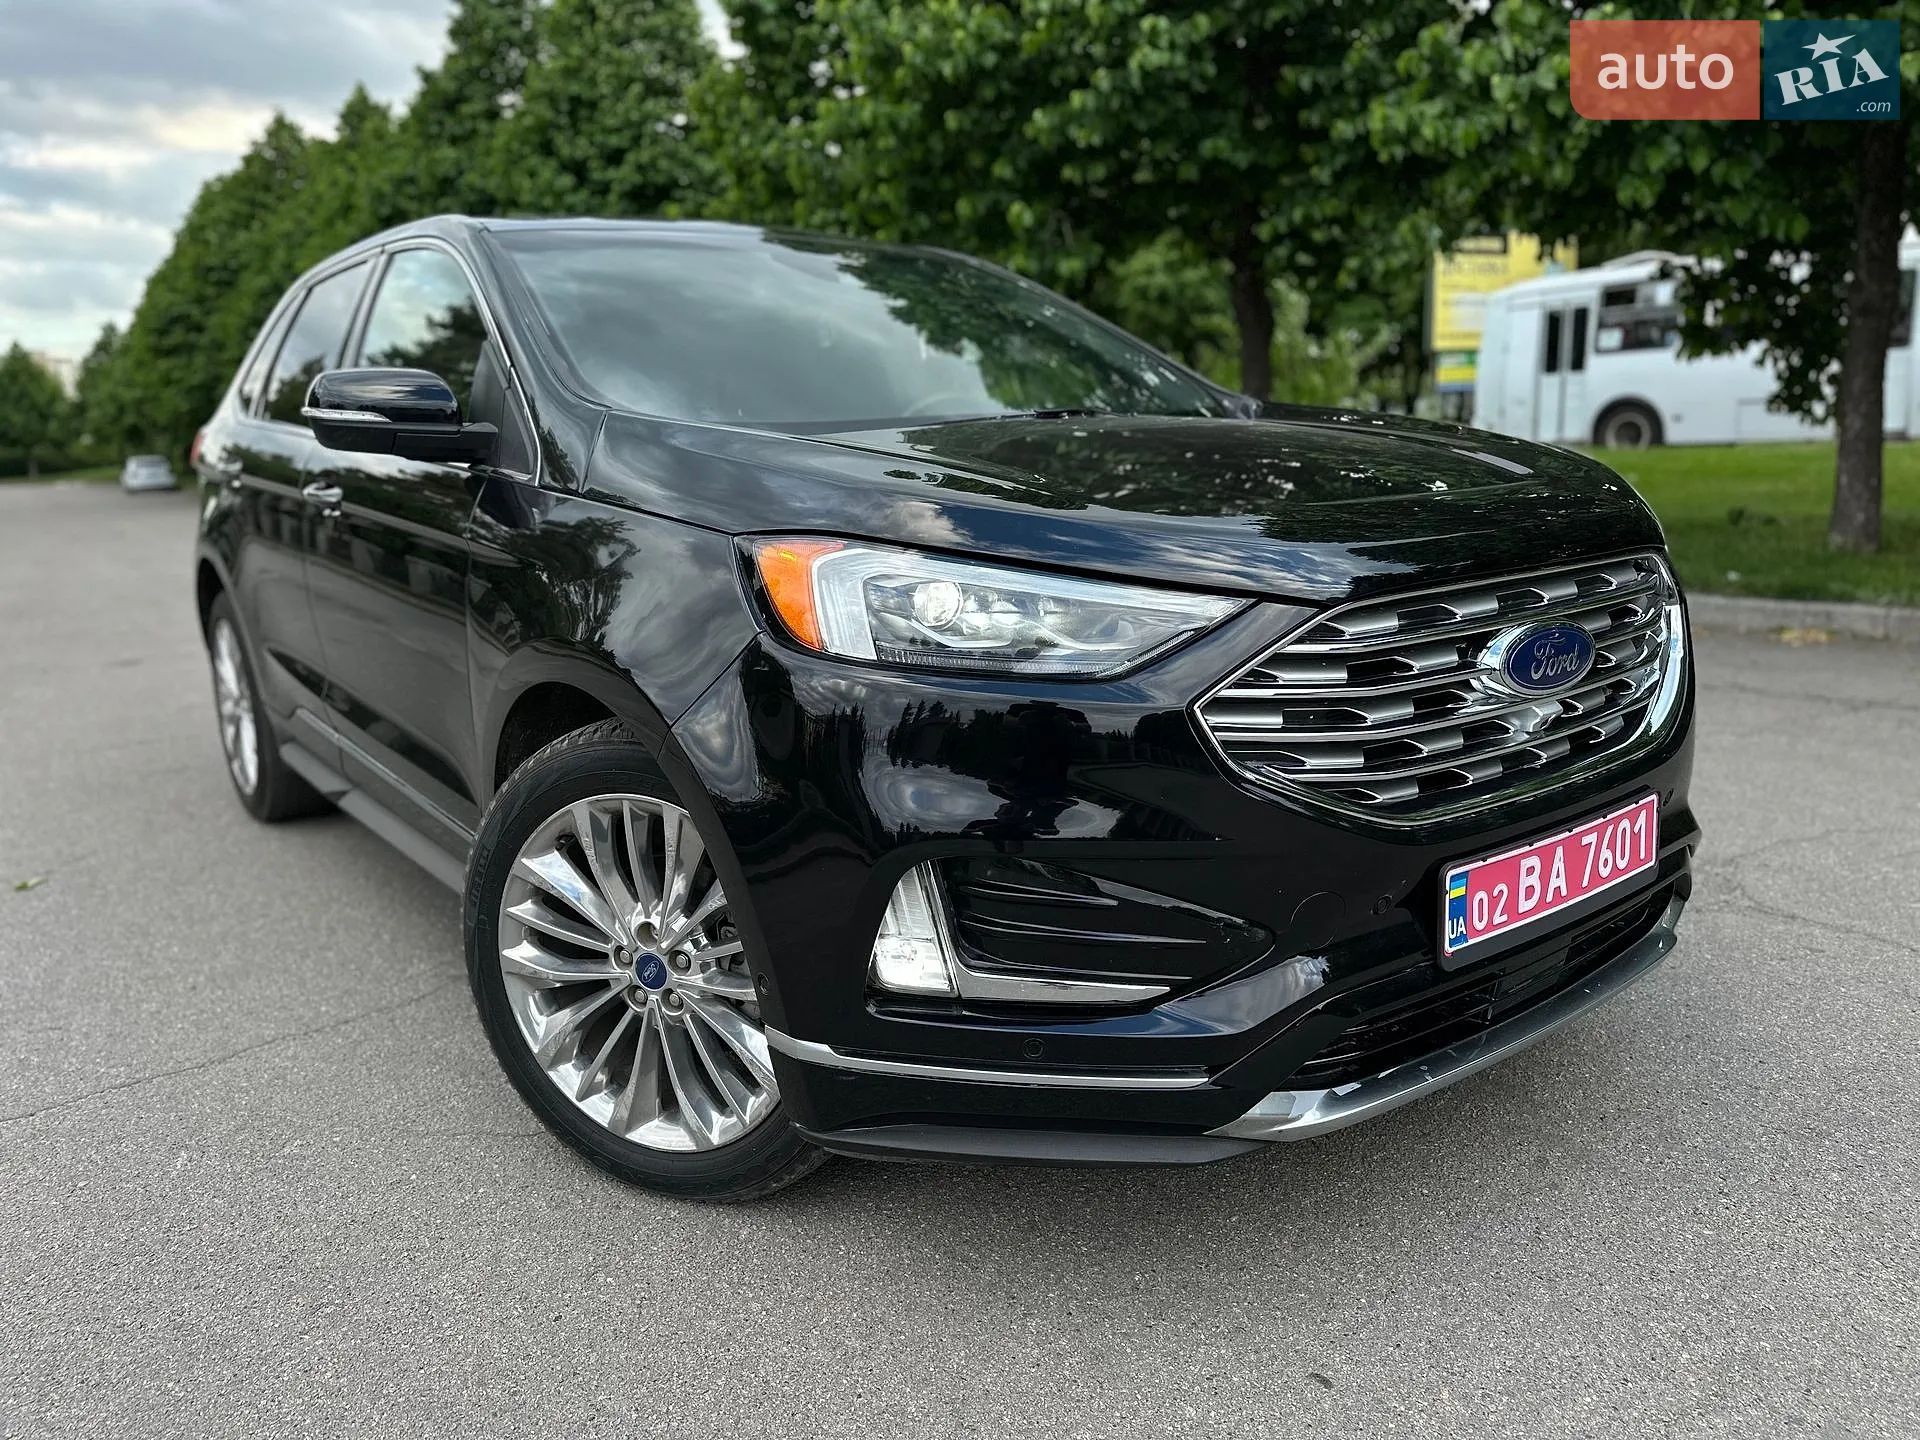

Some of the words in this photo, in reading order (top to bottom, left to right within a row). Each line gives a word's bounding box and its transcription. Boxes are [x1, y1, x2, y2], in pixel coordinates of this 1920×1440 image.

[1530, 637, 1580, 680] Ford
[1472, 883, 1508, 931] 02
[1518, 845, 1568, 914] BA
[1581, 809, 1647, 888] 7601
[1449, 916, 1467, 939] UA
